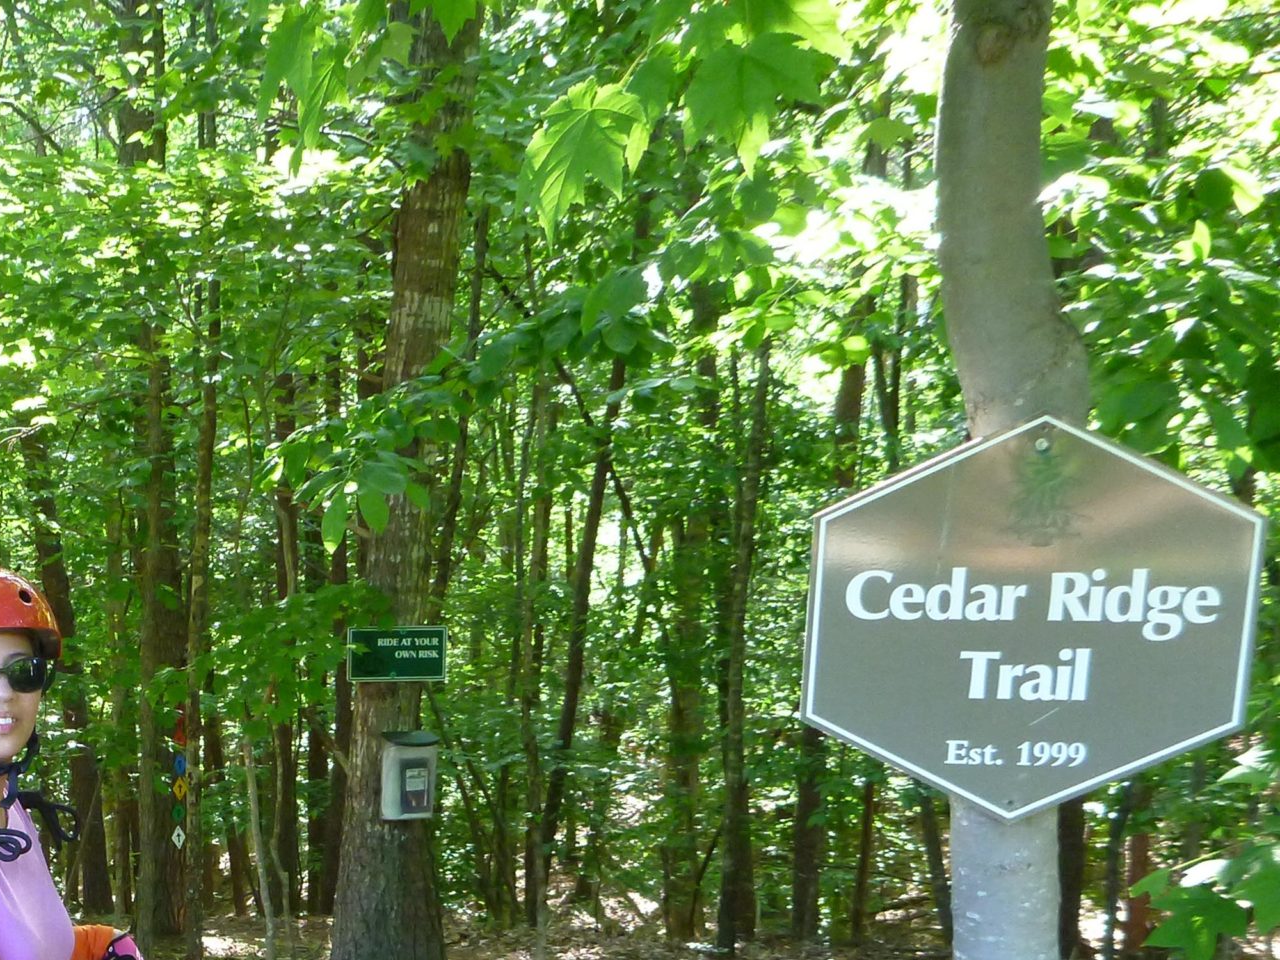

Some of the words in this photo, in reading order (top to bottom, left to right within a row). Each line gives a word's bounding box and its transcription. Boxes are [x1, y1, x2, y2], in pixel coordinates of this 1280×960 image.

[845, 567, 1028, 621] Cedar
[1046, 568, 1221, 641] Ridge
[377, 638, 400, 647] RIDE
[400, 637, 413, 646] AT
[413, 637, 440, 646] YOUR
[394, 650, 417, 659] OWN
[418, 650, 440, 658] RISK
[959, 647, 1093, 701] Trail
[944, 739, 1004, 766] Est.
[1015, 741, 1087, 767] 1999
